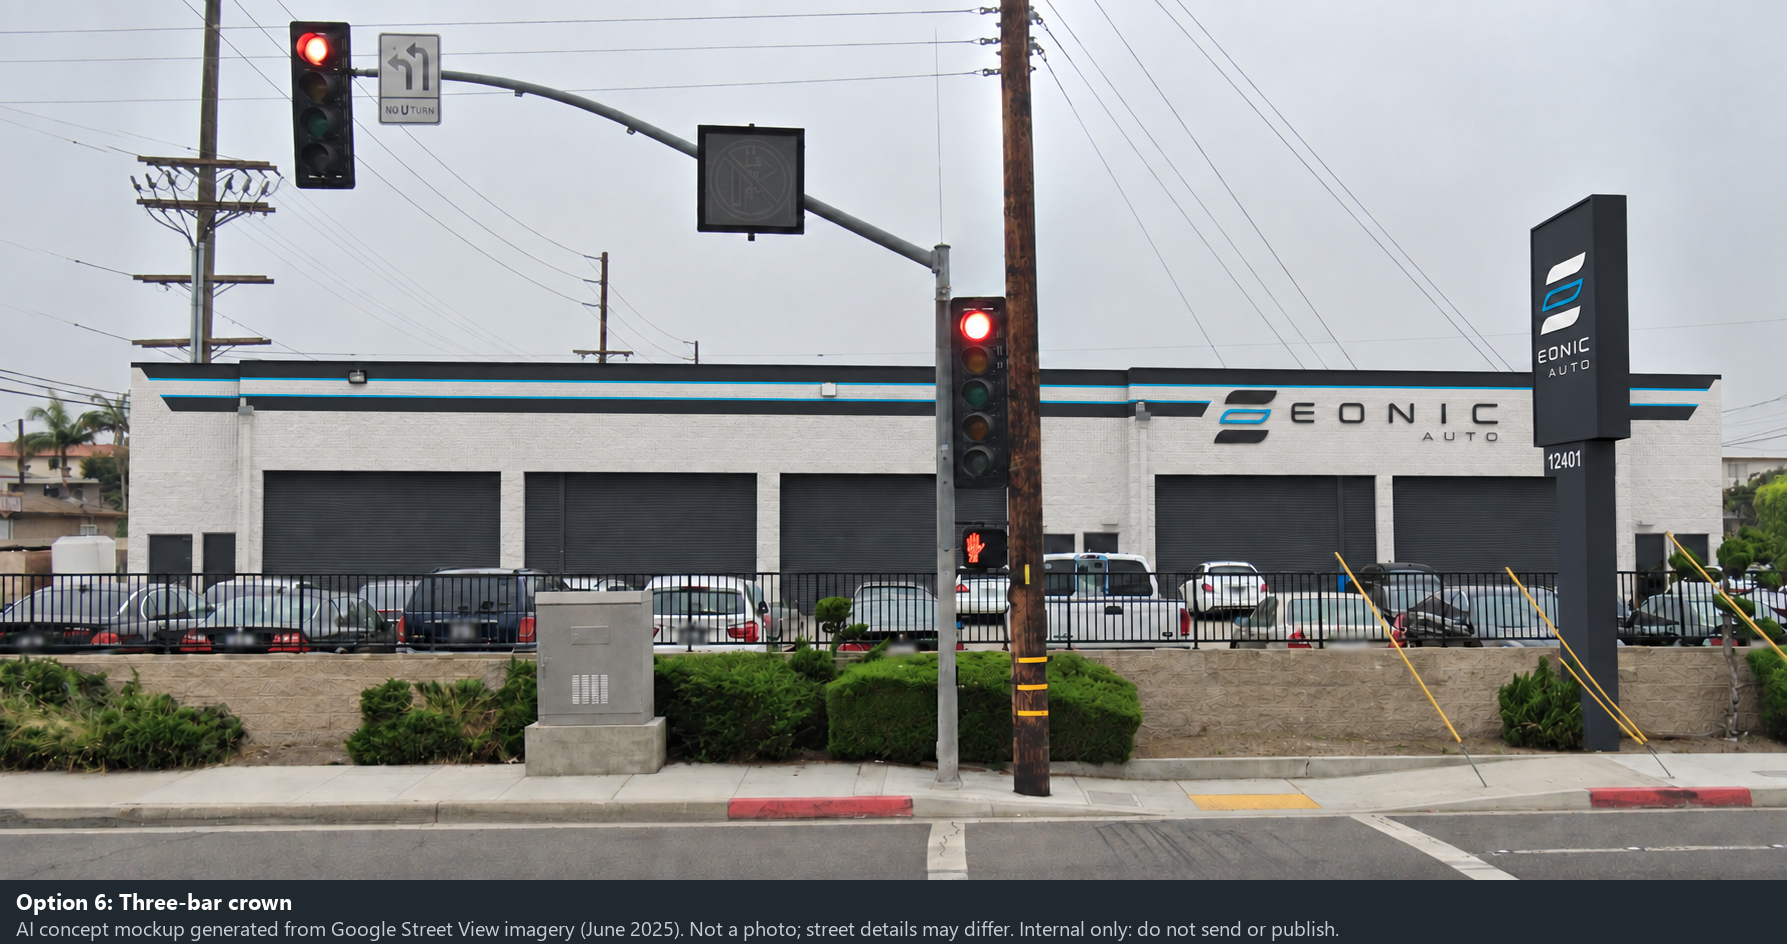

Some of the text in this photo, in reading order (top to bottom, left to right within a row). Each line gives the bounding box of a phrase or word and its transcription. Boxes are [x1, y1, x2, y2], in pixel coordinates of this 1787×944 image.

[385, 105, 435, 115] NO U TURN
[1537, 336, 1590, 364] EONIC
[1548, 359, 1590, 378] AUTO
[1291, 402, 1499, 425] EONIC
[1422, 431, 1499, 442] AUTO
[1547, 449, 1581, 470] 12401
